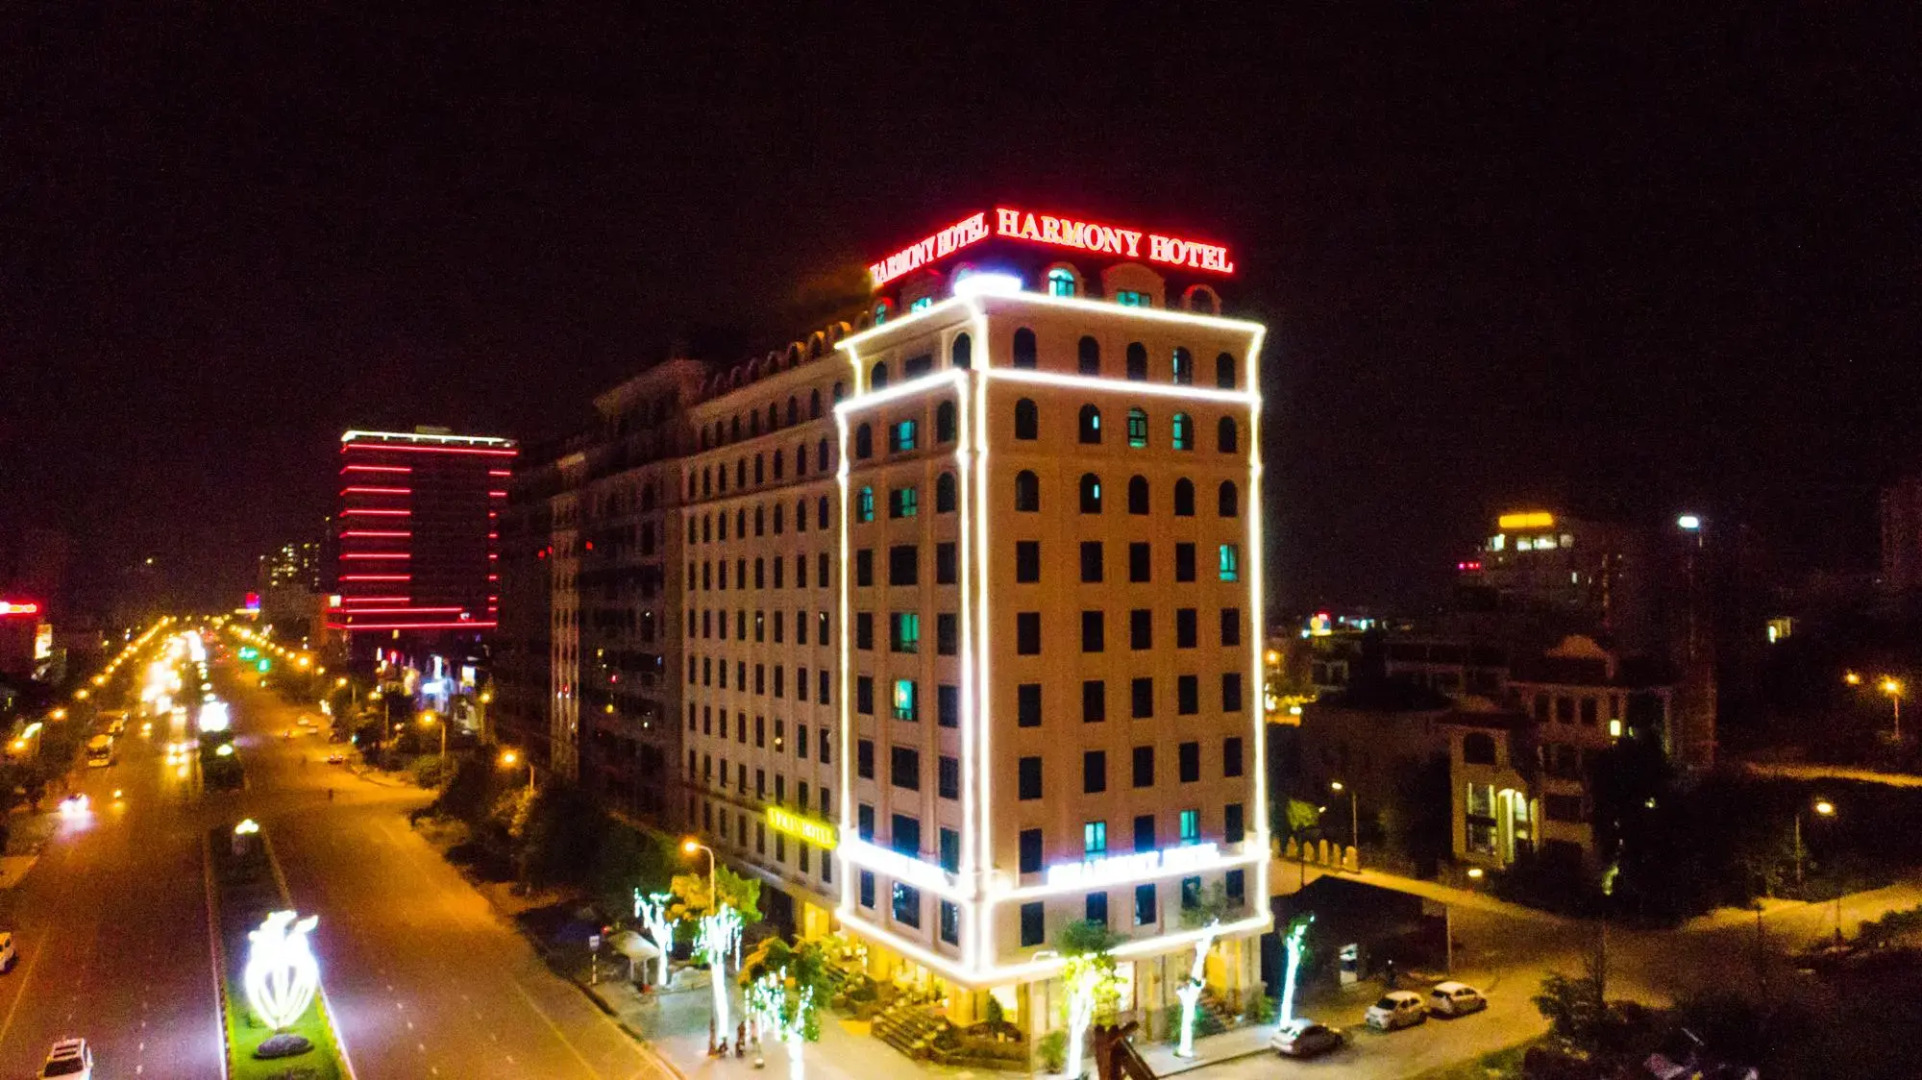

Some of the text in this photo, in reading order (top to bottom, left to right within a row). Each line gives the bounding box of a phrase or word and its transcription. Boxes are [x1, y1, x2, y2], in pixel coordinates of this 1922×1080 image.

[937, 212, 989, 258] HOTEL
[996, 208, 1234, 274] HARMONY HOTEL
